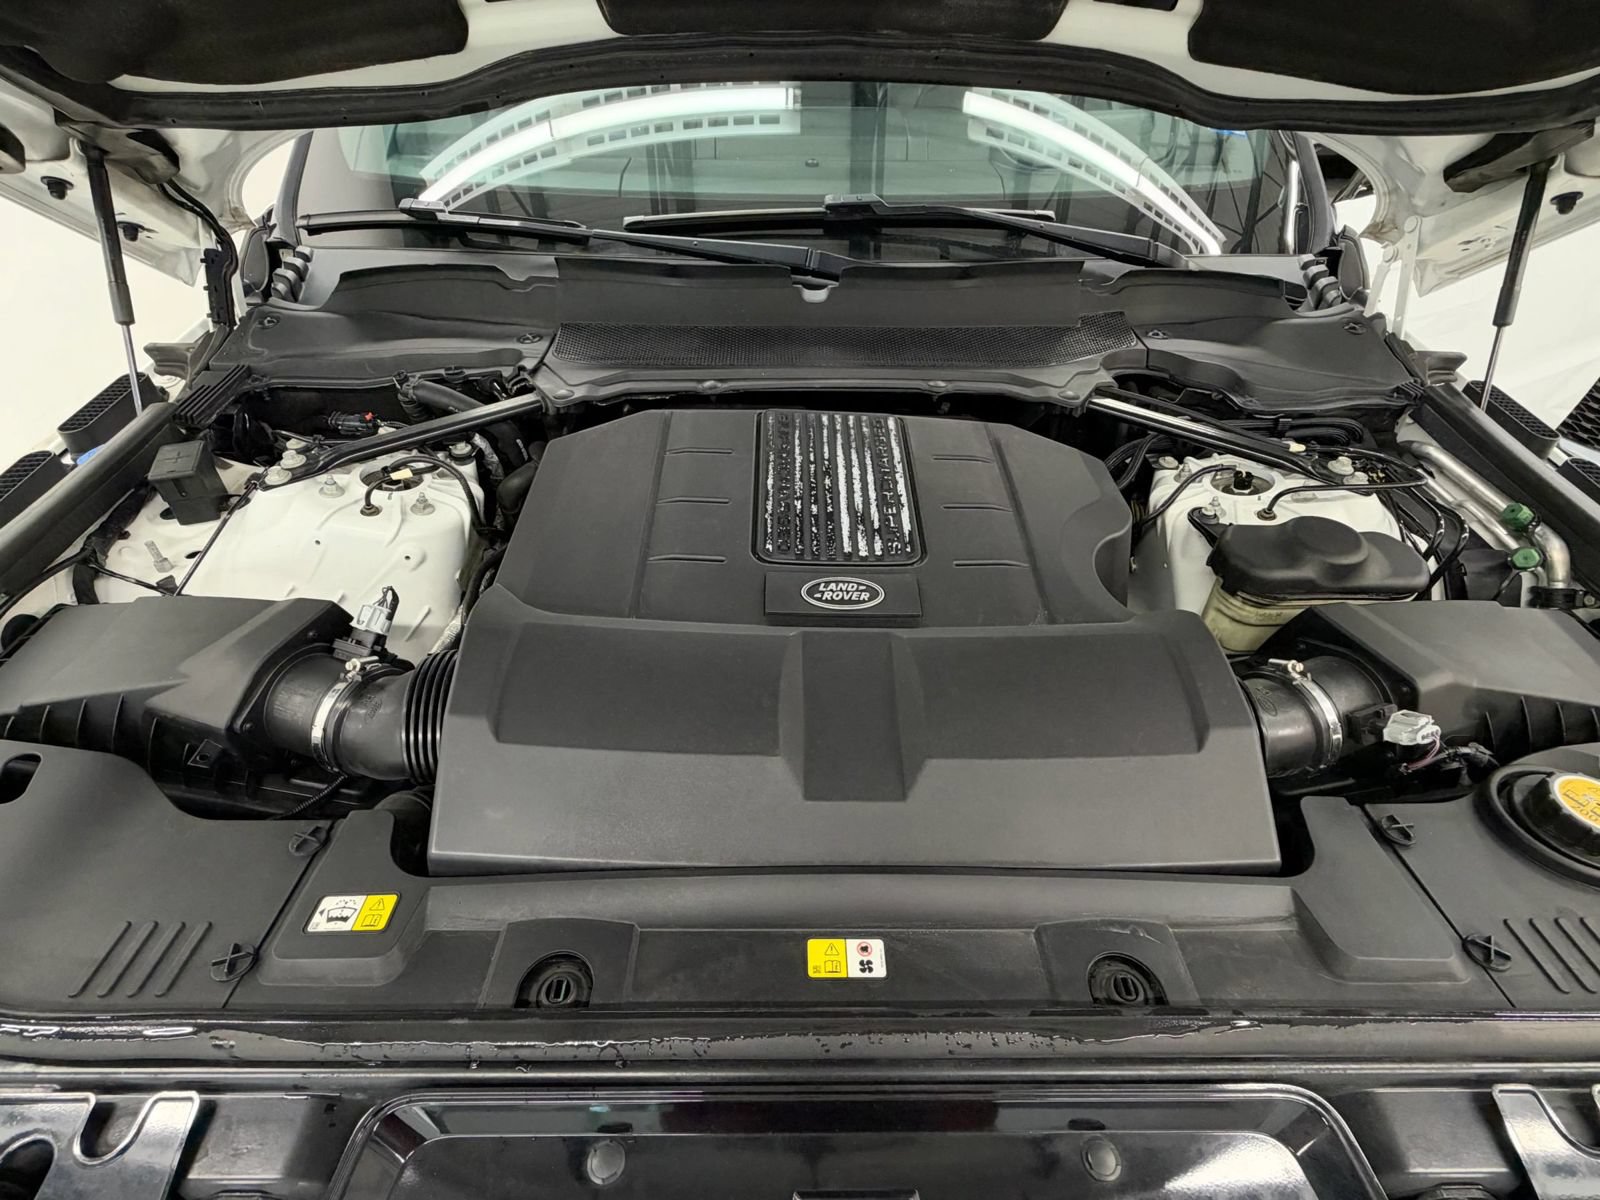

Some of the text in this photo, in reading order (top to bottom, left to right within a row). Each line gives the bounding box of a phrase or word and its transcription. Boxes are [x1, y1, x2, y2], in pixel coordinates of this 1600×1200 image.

[872, 418, 902, 555] SUPERCHARGED
[818, 582, 858, 592] LAND
[821, 591, 871, 601] ROVER
